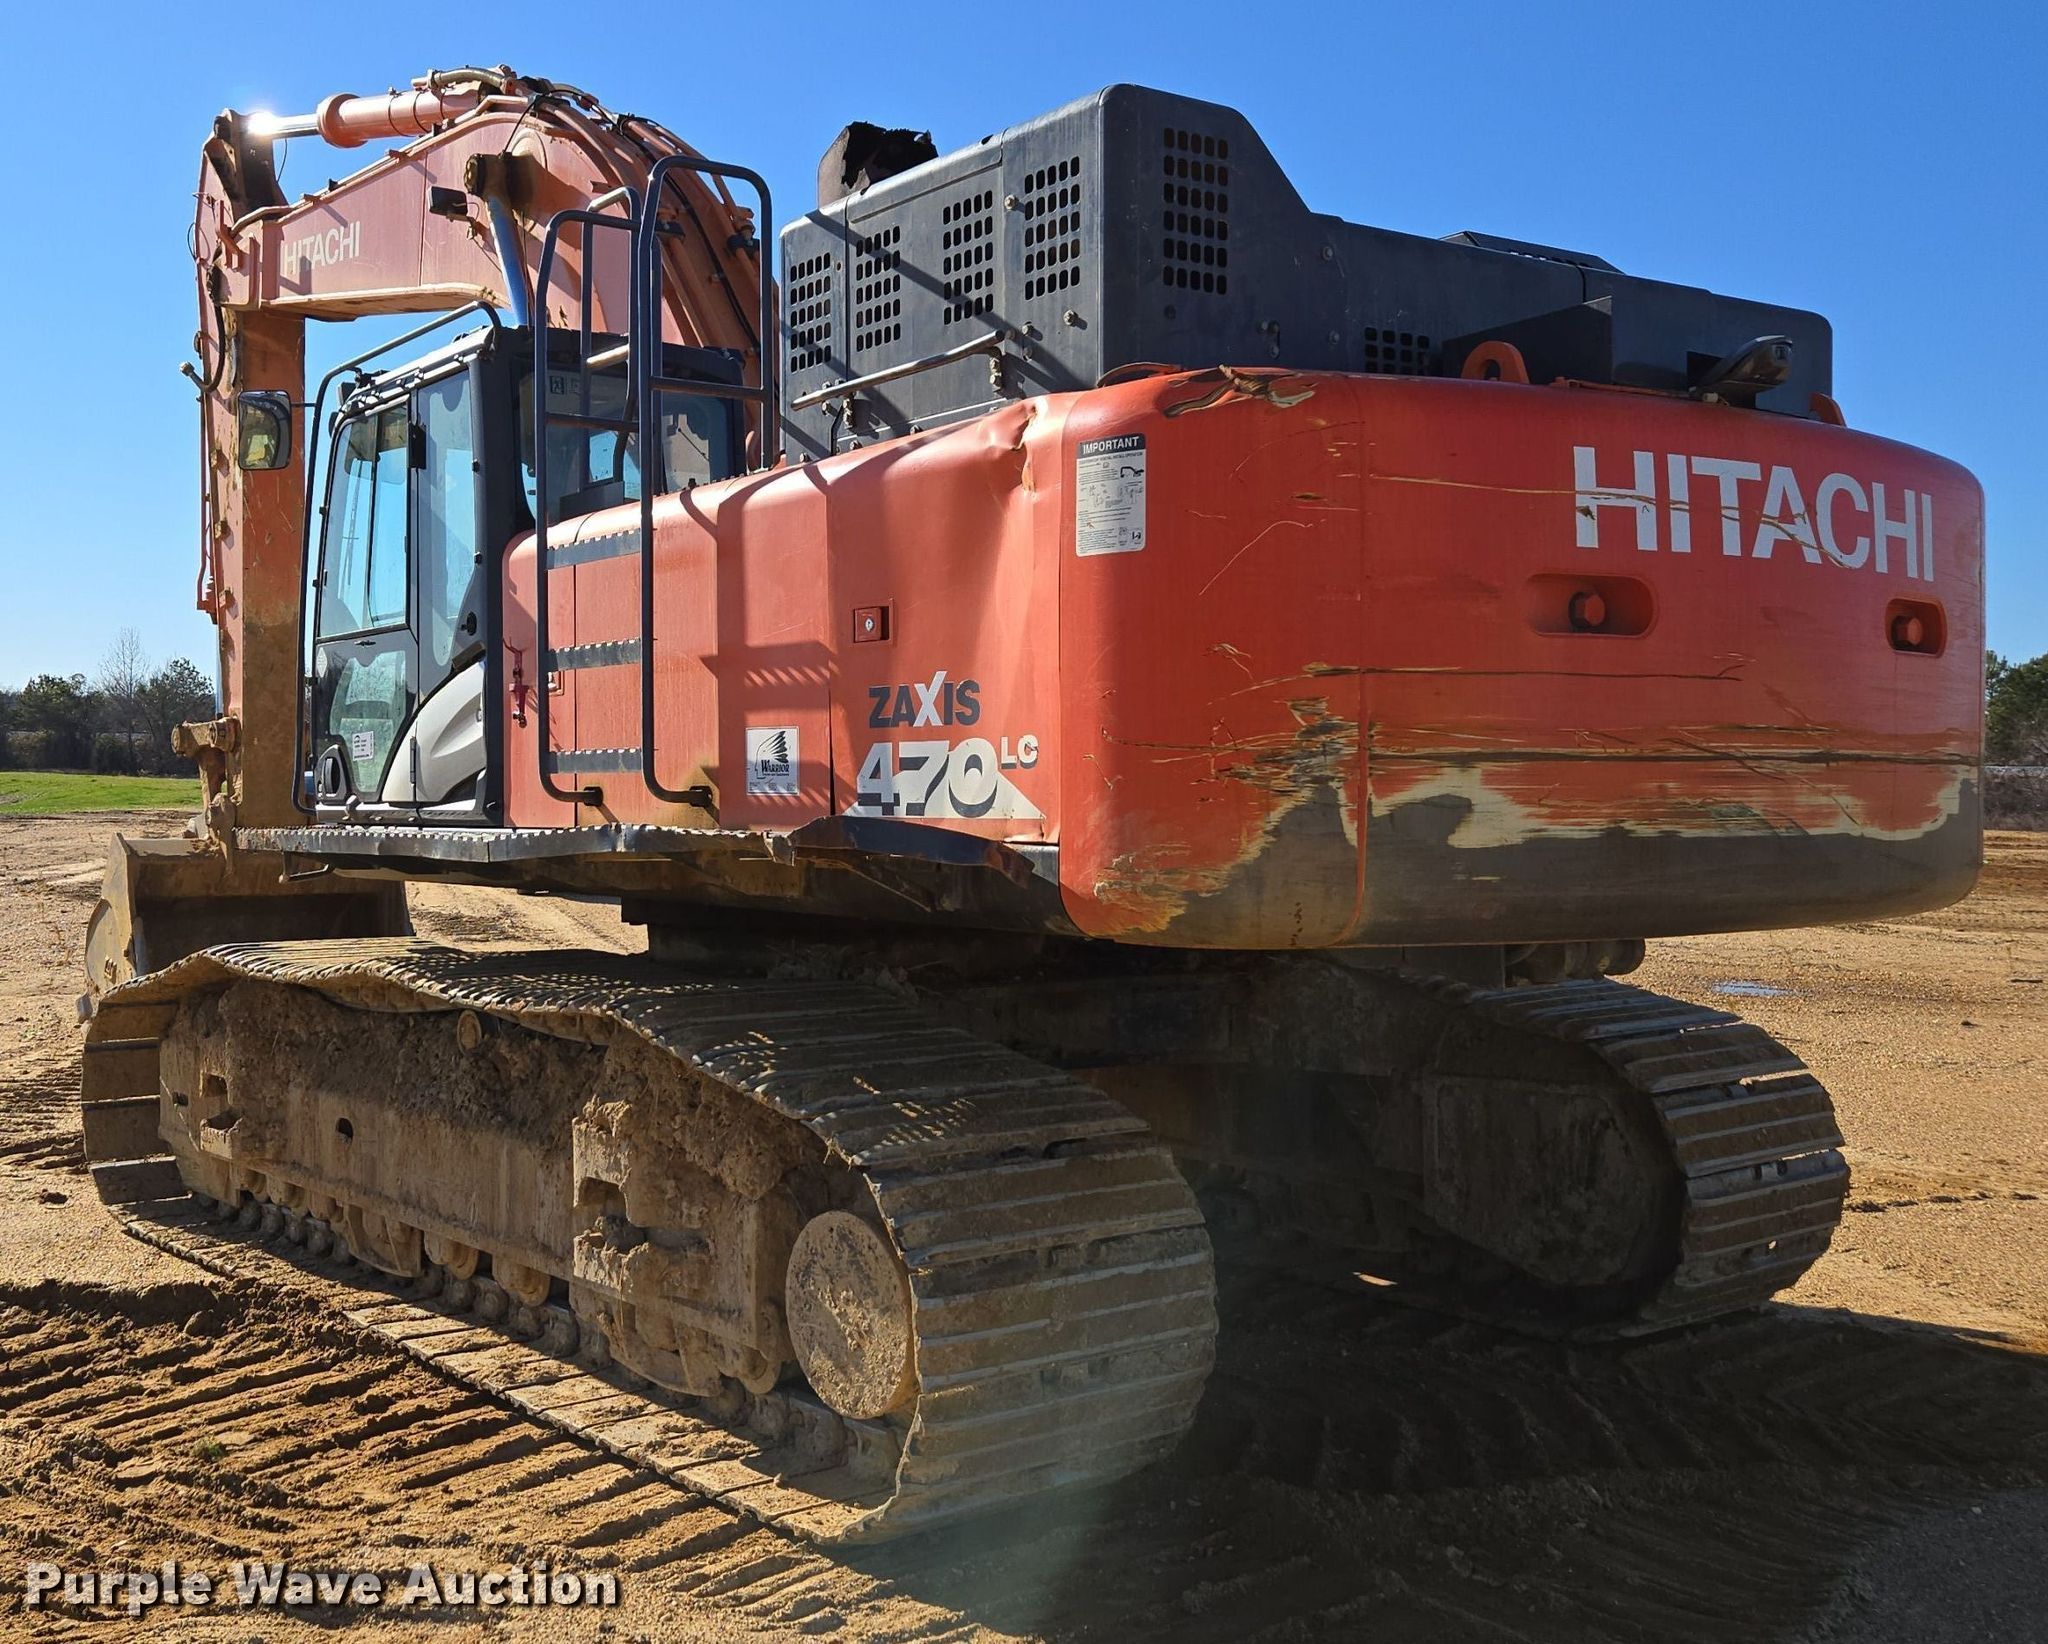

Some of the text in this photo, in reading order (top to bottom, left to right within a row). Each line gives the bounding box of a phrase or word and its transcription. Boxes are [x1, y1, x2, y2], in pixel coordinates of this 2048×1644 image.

[284, 221, 360, 276] HITACHI
[1083, 436, 1140, 454] IMPORTANT
[1573, 446, 1934, 582] HITACHI
[868, 670, 981, 728] ZAXIS
[857, 737, 998, 818] 470
